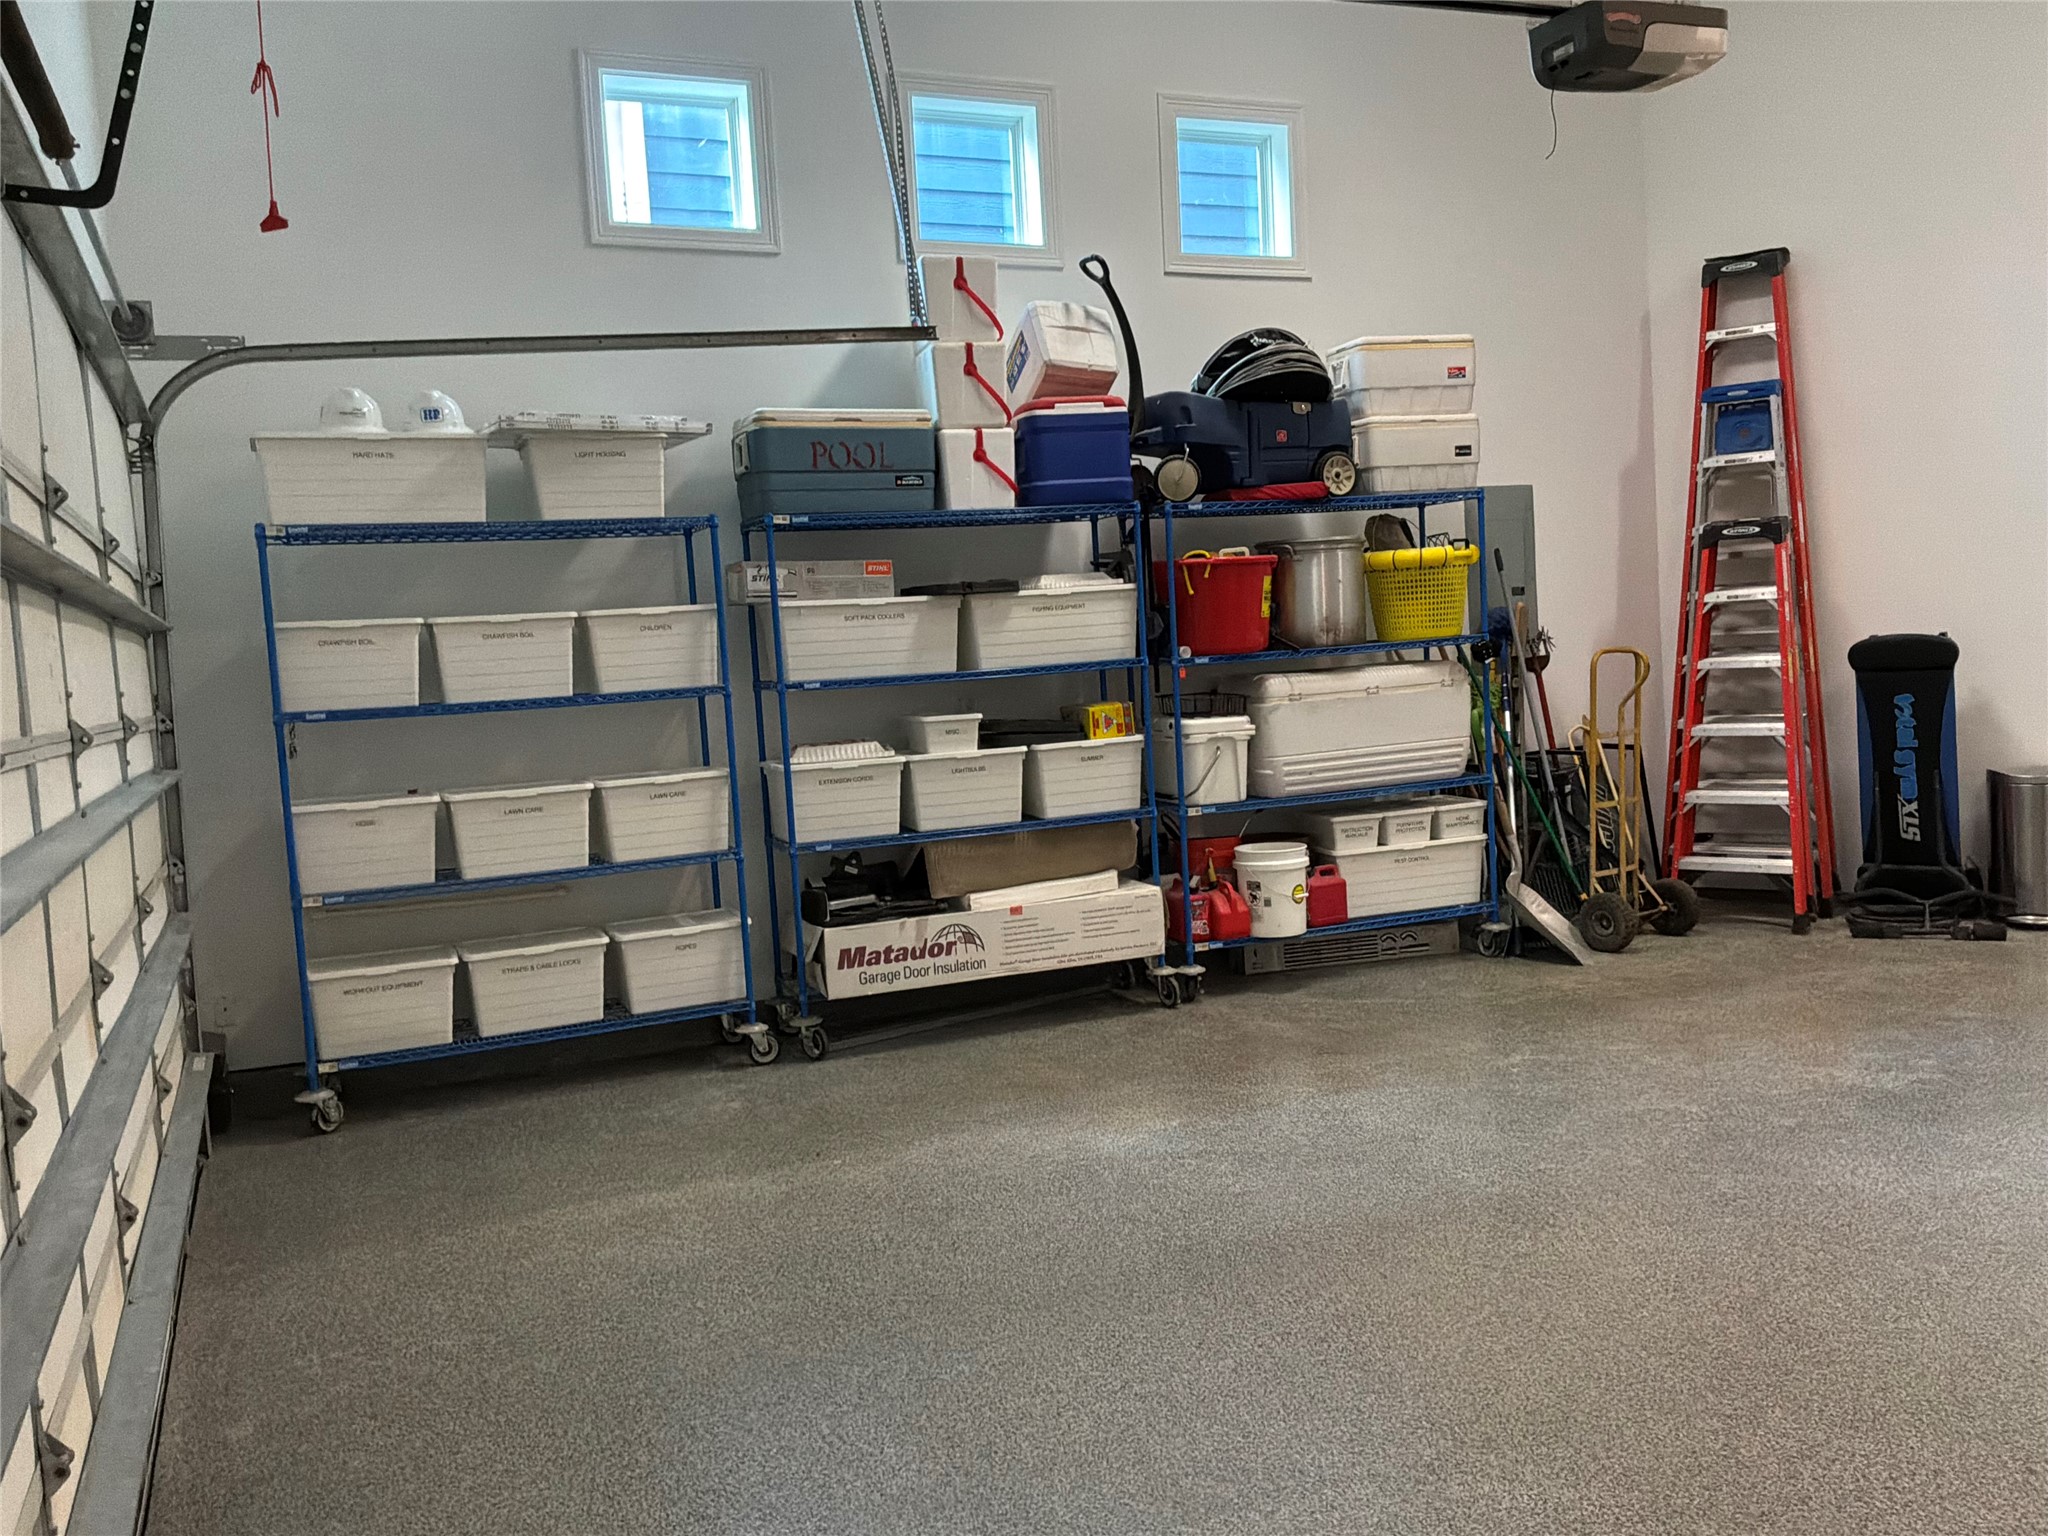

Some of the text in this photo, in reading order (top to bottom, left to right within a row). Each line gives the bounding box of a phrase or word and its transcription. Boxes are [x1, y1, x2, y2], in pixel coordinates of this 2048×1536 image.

[574, 451, 594, 459] LIGHT
[810, 440, 894, 470] POOL
[867, 564, 889, 572] STIHL
[877, 612, 905, 620] COOLERS
[639, 624, 672, 632] CHILDREN
[481, 632, 518, 640] CRAWFISH
[818, 777, 852, 786] EXTENSION
[649, 792, 668, 801] LAWN
[503, 806, 544, 816] LAWN CARE
[1408, 855, 1430, 863] CONTROL
[837, 938, 957, 970] Matador
[858, 957, 987, 985] Garage Door Insulation
